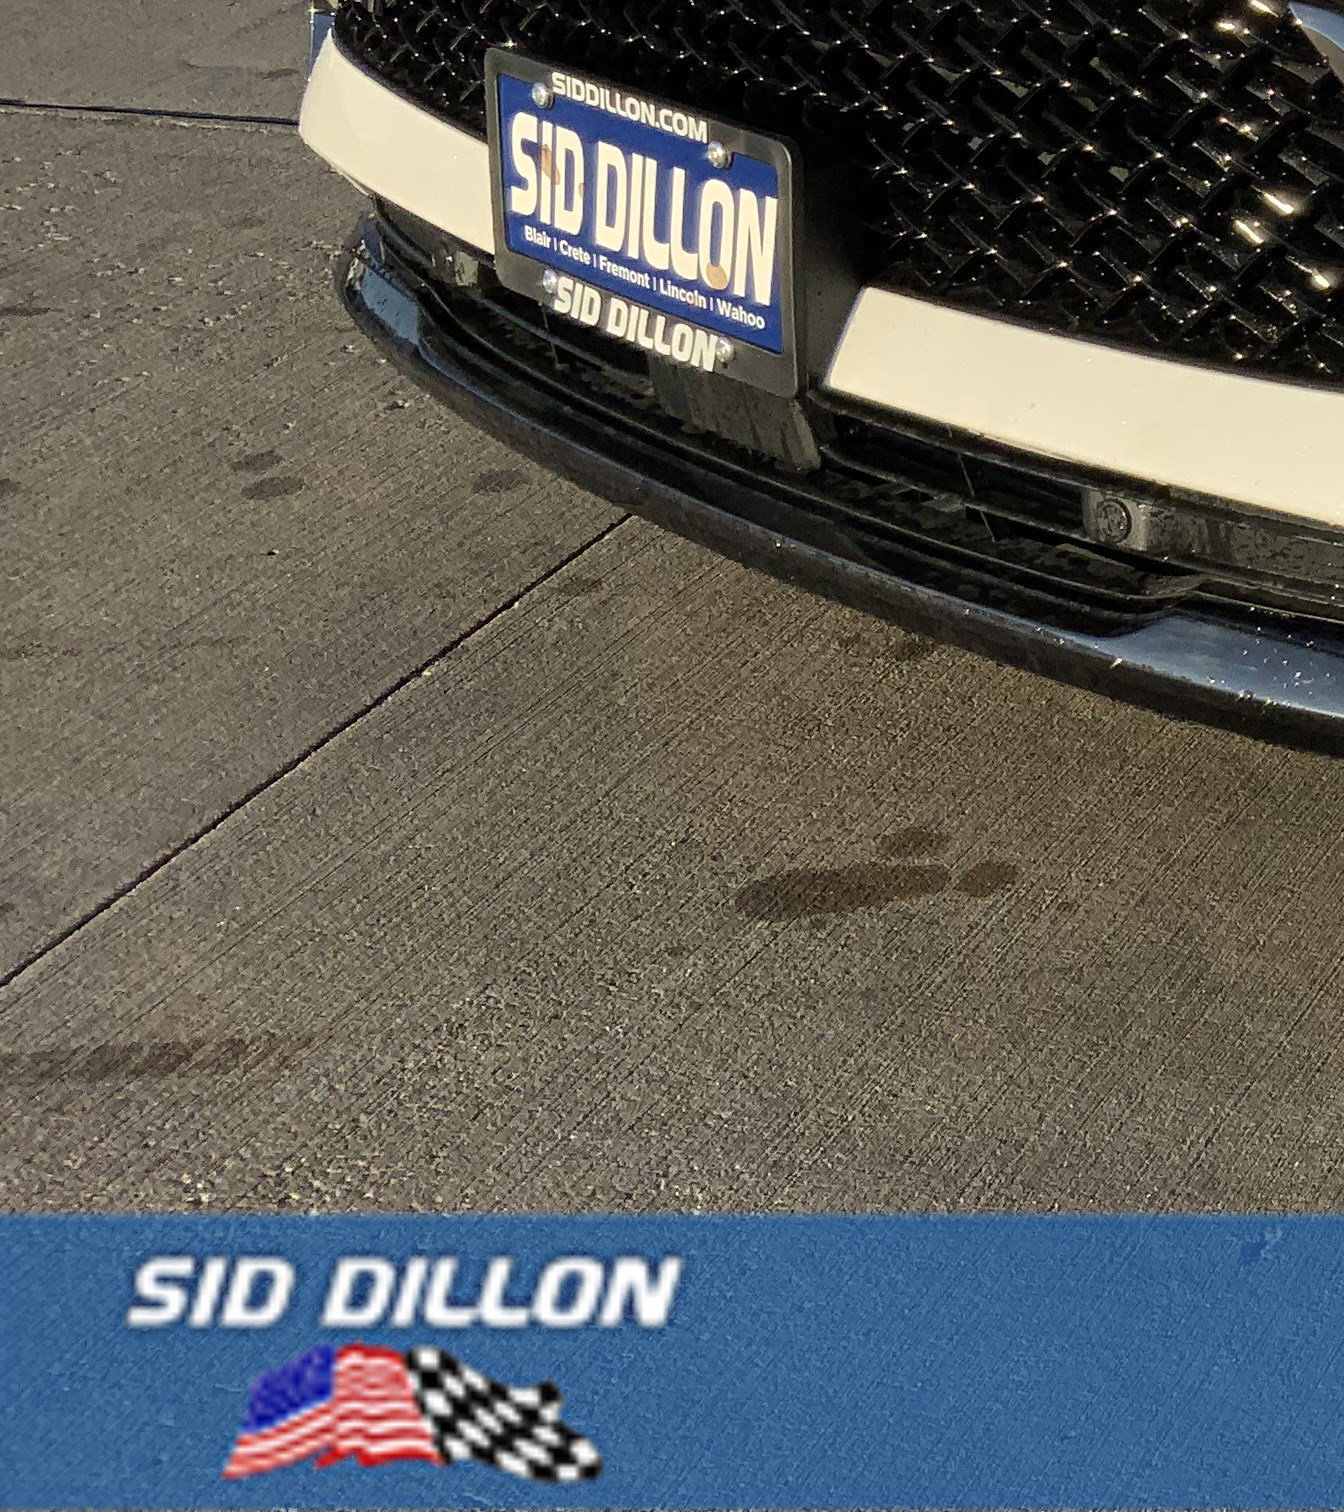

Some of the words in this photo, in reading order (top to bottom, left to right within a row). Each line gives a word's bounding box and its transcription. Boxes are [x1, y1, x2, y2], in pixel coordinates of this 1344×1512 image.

[551, 71, 709, 144] SIDDILLON.COM
[510, 111, 585, 236] SID
[594, 140, 778, 307] DILLON
[524, 225, 551, 249] Blair
[559, 240, 591, 266] Crete
[599, 255, 651, 289] Fremont
[659, 278, 707, 311] Lincoln
[716, 298, 766, 330] Wahoo
[554, 276, 602, 327] SID
[606, 293, 719, 373] DILLON
